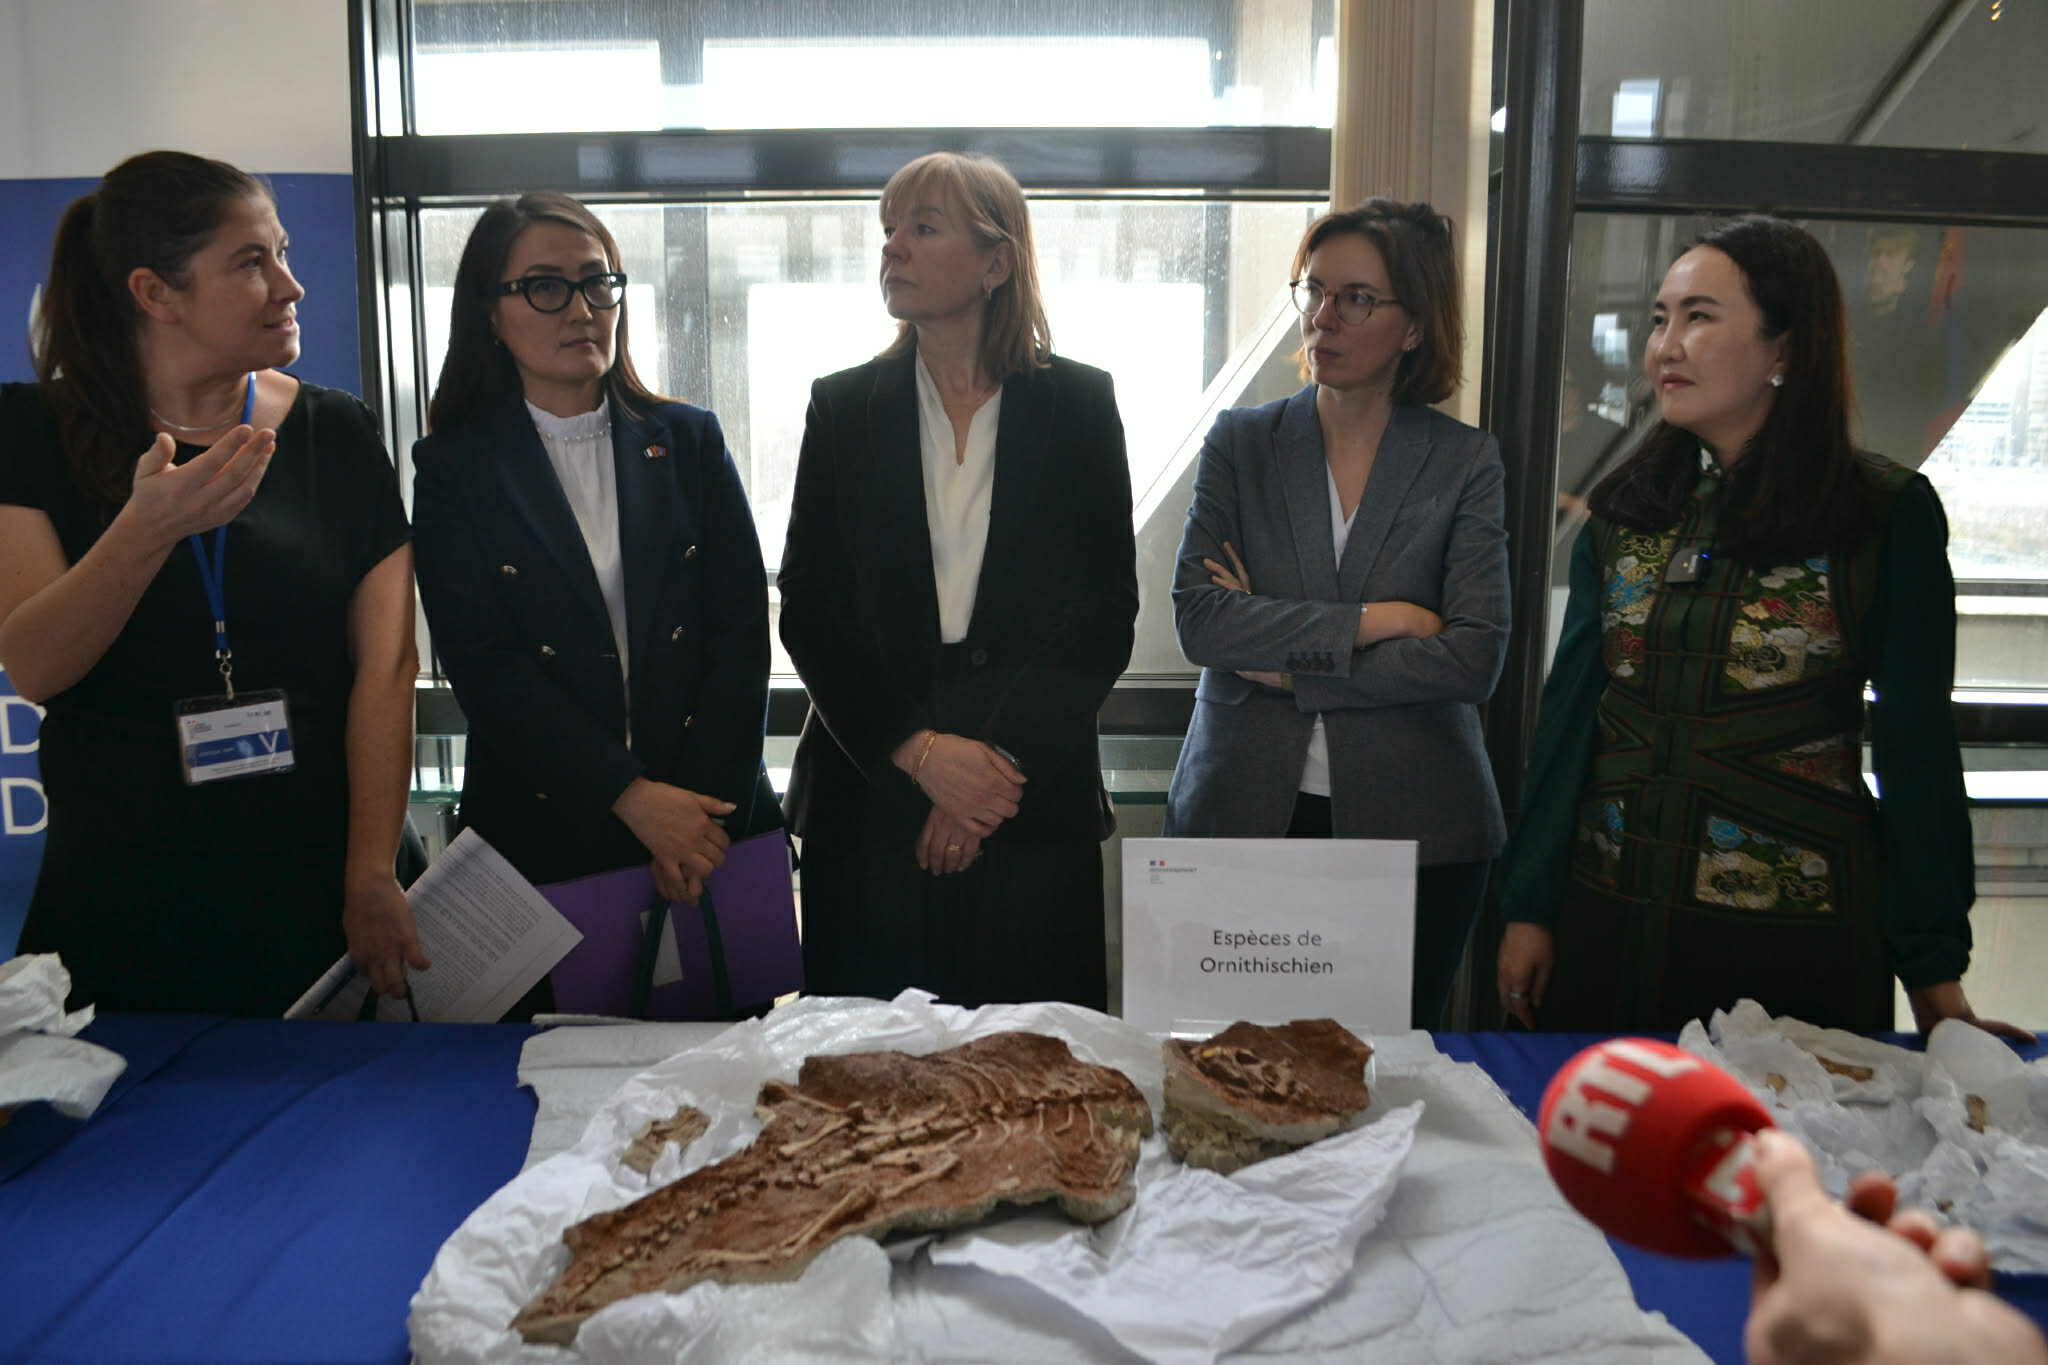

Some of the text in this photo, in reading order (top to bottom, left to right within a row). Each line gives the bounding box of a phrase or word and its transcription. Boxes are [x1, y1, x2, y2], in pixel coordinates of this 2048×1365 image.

[1213, 930, 1322, 949] Espèces de
[1200, 957, 1334, 974] Ornithischien
[1547, 1040, 1703, 1176] RTL
